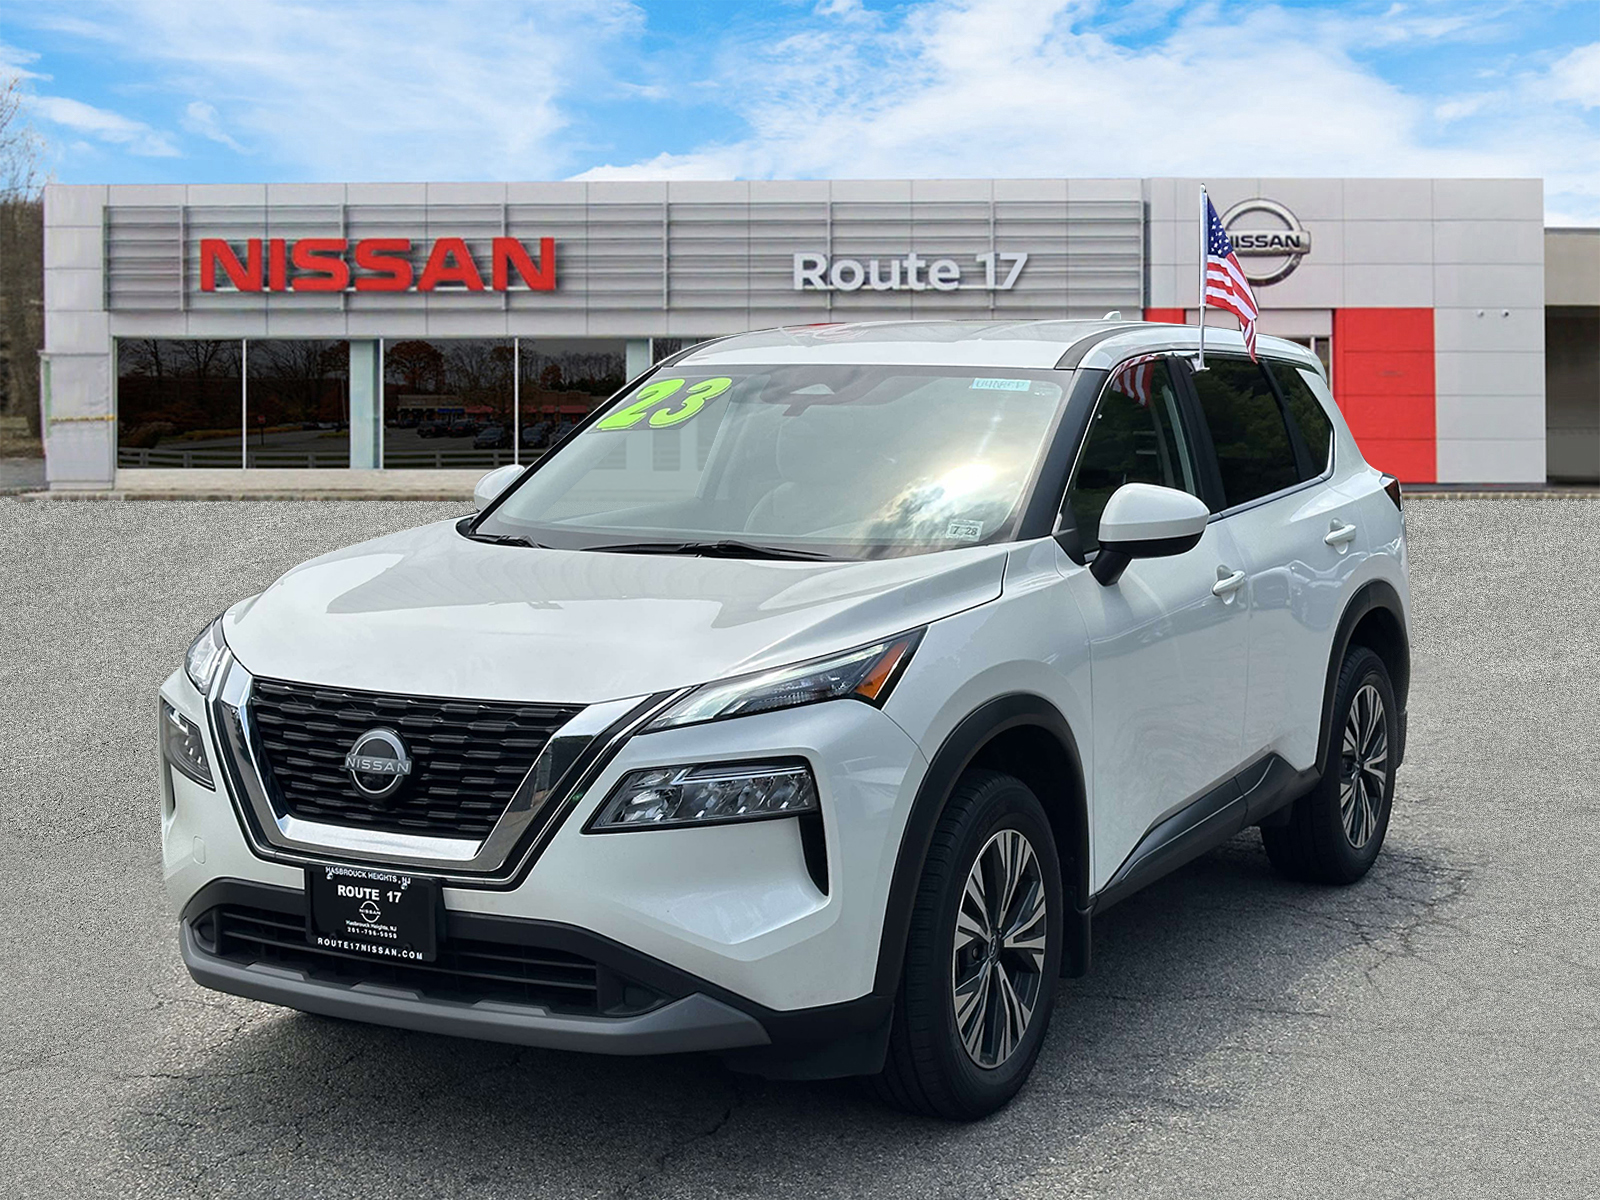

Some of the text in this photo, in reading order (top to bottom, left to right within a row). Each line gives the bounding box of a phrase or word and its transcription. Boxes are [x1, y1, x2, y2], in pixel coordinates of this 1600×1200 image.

[1229, 235, 1300, 248] ISSAN
[200, 237, 555, 292] NISSAN
[793, 251, 1028, 291] Route 17
[596, 377, 732, 430] 23
[964, 527, 978, 536] 28
[346, 757, 409, 773] NISSAN
[325, 866, 367, 879] HASBROUCK
[337, 884, 402, 903] ROUTE 17
[359, 908, 381, 916] NISSAN
[317, 937, 423, 960] ROUTE17NISSAN.COM
